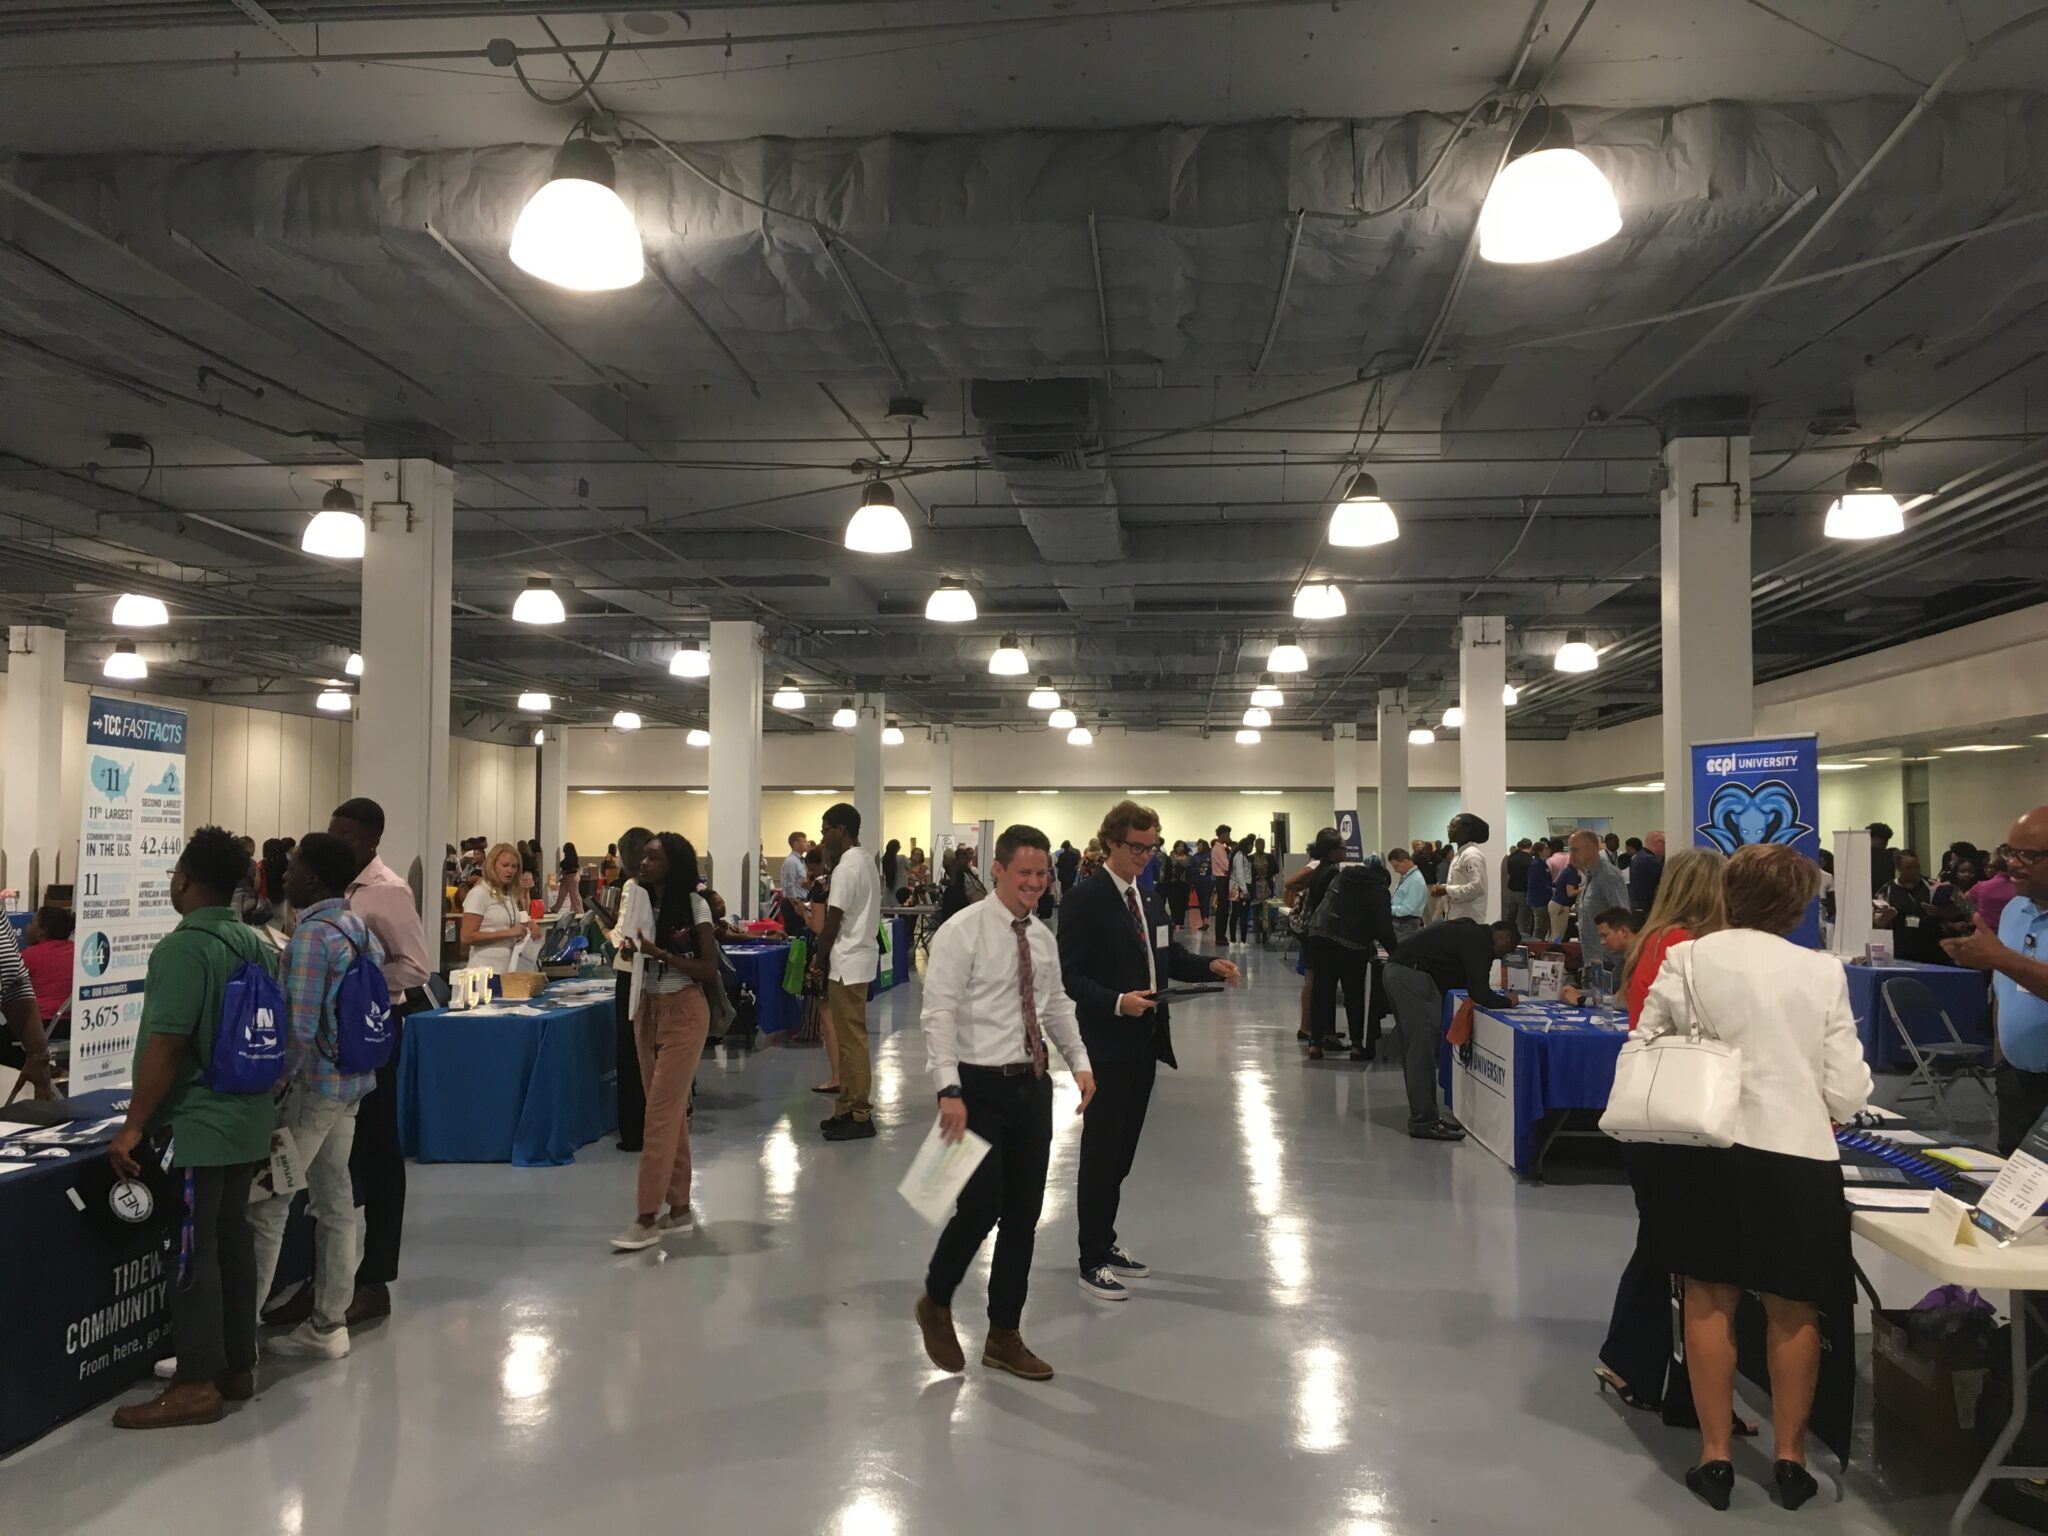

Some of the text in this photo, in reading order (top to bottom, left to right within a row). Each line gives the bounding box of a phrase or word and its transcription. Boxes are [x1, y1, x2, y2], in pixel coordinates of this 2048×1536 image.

[103, 714, 121, 736] TCC
[1706, 753, 1798, 776] ecpi UNIVERSITY
[105, 808, 133, 820] LARGEST
[142, 799, 181, 808] SECOND LARGEST
[86, 833, 114, 841] COMMUNITY
[140, 835, 180, 858] 42,440
[86, 843, 132, 856] IN THE U.S.
[84, 872, 98, 896] 11
[139, 890, 159, 898] AFRICAN
[83, 910, 104, 919] DEGREE
[106, 908, 130, 918] PROGRAMS
[81, 1001, 144, 1031] 3,675 GRA
[1473, 1053, 1506, 1087] UNIVERSITY
[280, 1154, 294, 1187] FUTURE
[118, 1182, 144, 1217] NEL
[113, 1250, 165, 1296] TIDEW
[66, 1281, 168, 1355] COMMUNITY
[79, 1352, 109, 1380] From
[113, 1335, 143, 1365] here,
[147, 1330, 160, 1349] go
